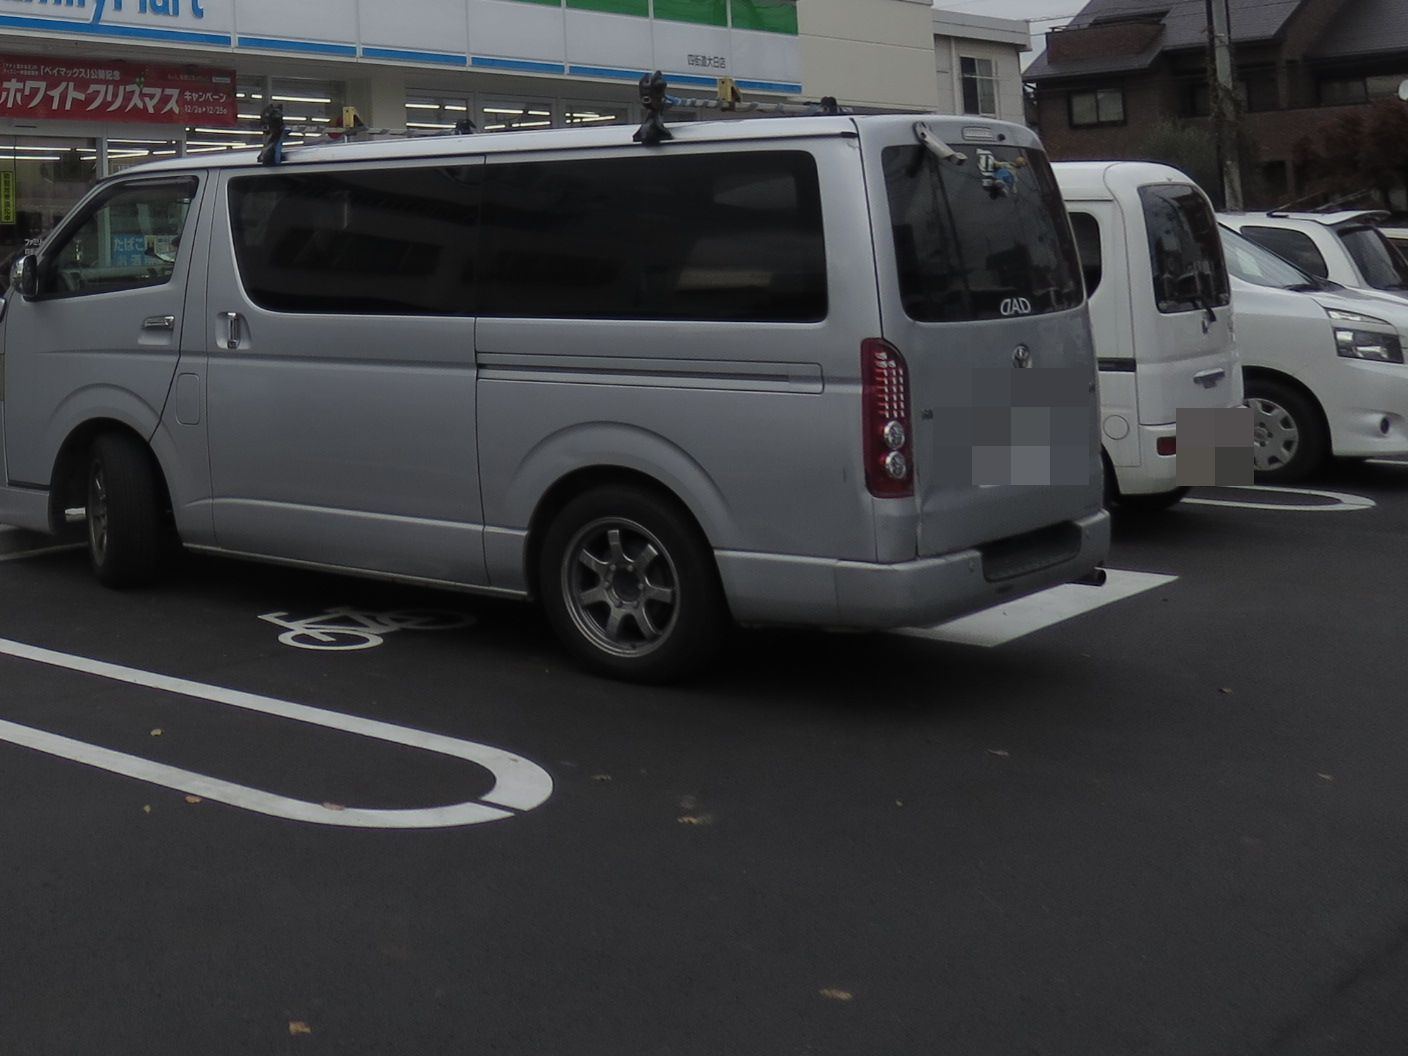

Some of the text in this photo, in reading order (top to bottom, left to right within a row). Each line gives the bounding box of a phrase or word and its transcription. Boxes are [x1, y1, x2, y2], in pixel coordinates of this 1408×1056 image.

[0, 78, 180, 114] ホワイトクリスマス
[184, 91, 226, 103] キャンペーン
